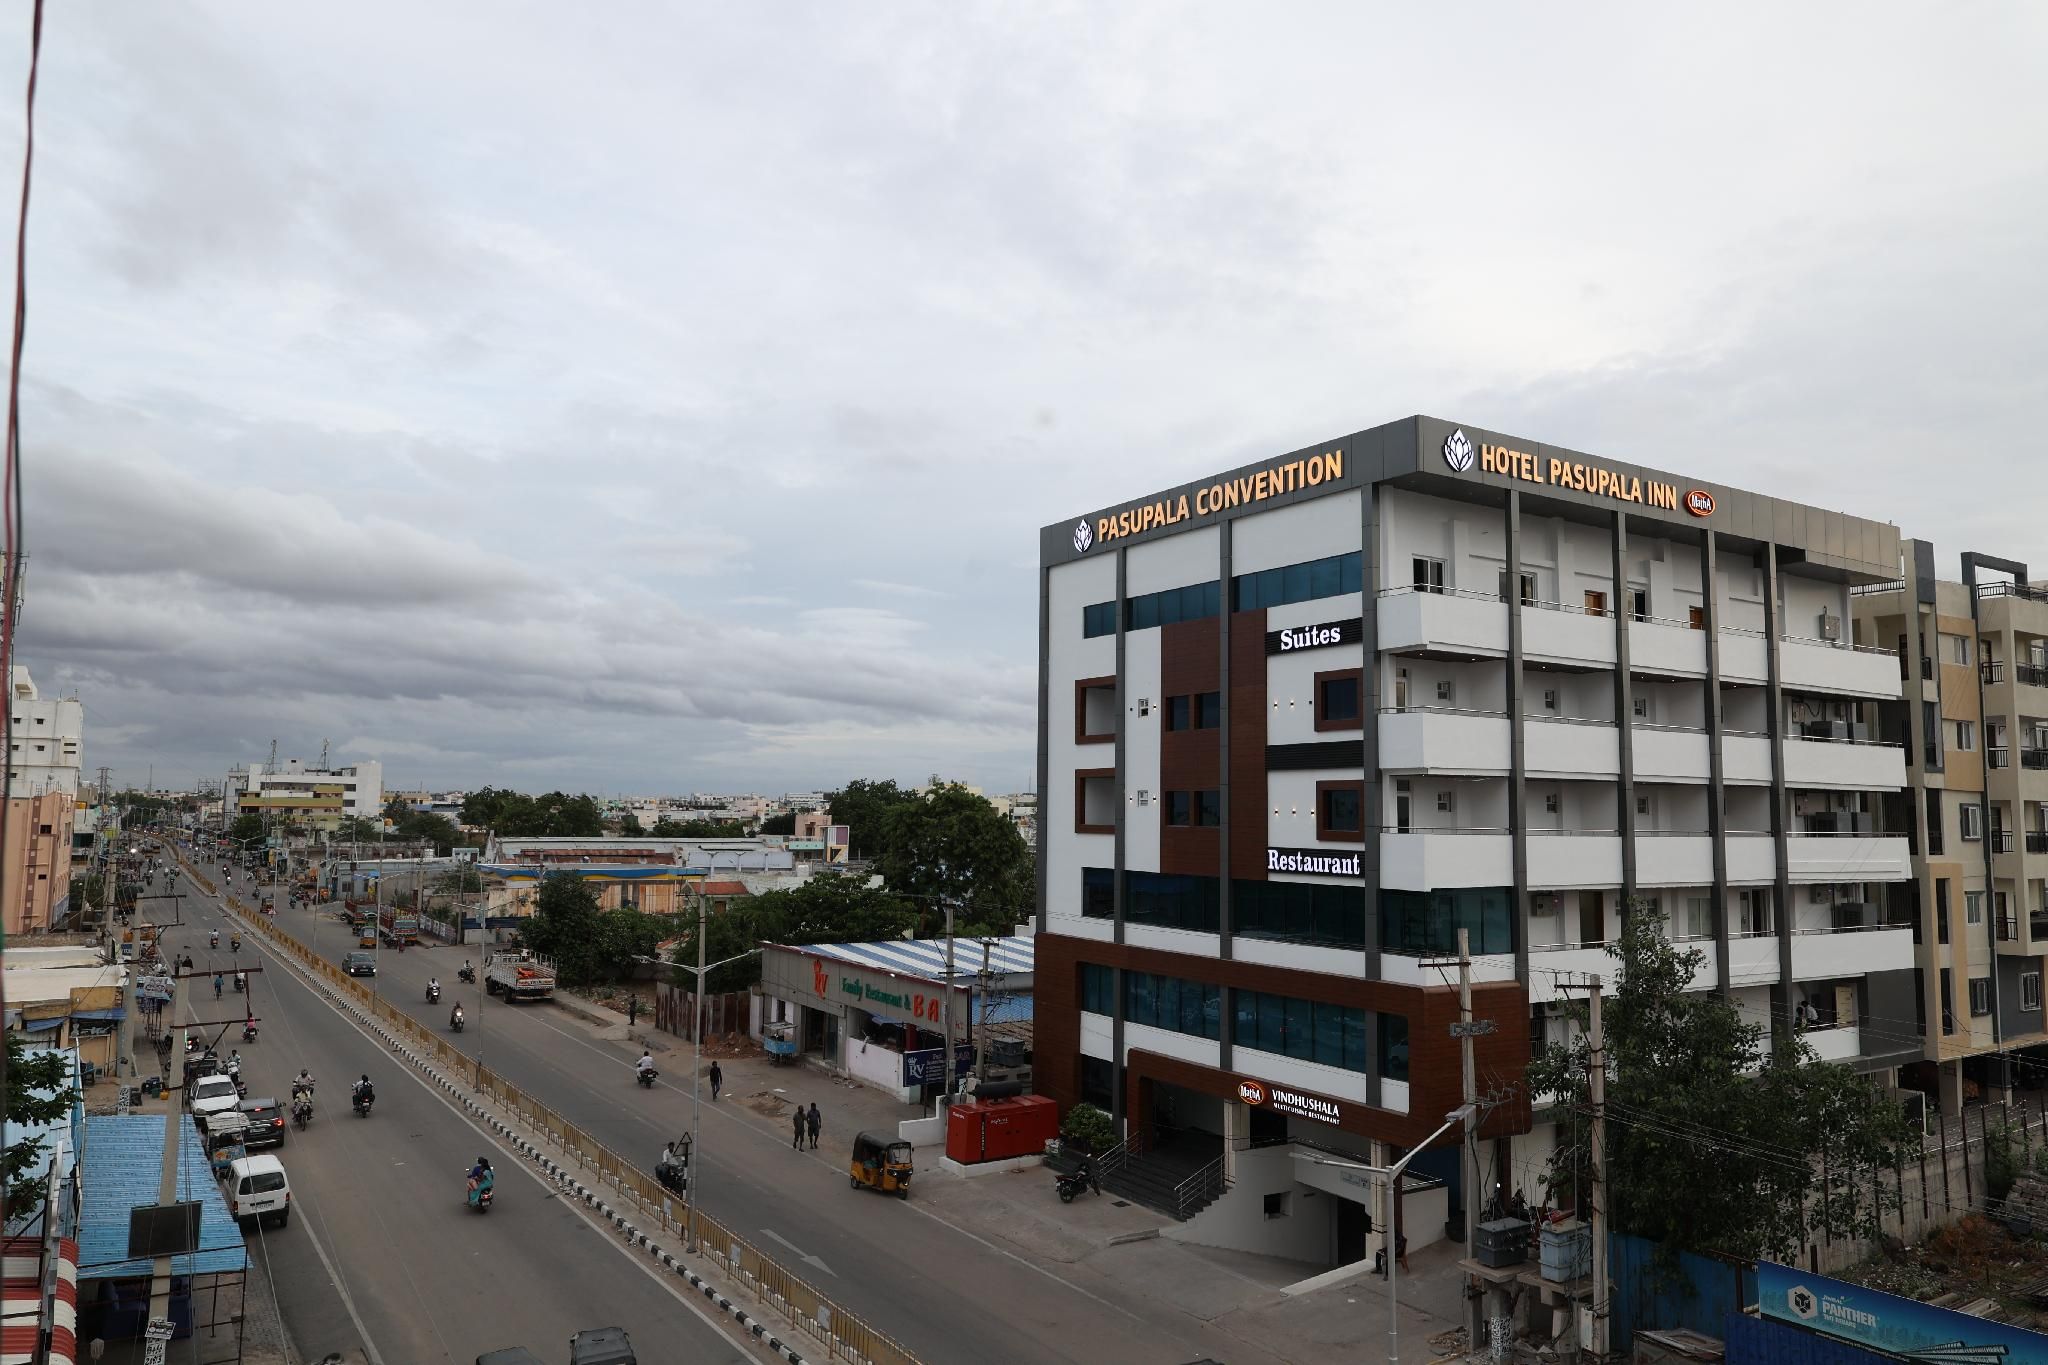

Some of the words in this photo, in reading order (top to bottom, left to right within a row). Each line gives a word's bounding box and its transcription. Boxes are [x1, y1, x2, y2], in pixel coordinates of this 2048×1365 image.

[1481, 443, 1543, 483] HOTEL
[1550, 458, 1642, 503] PASUPALA
[1648, 480, 1677, 511] INN
[1098, 494, 1190, 543] PASUPALA
[1196, 449, 1344, 516] CONVENTION
[1280, 625, 1341, 650] Suites
[1267, 849, 1360, 875] Restaurant
[842, 977, 863, 1001] Family
[908, 1064, 925, 1078] RV
[1272, 1089, 1340, 1117] VINDHUSHALA
[1273, 1102, 1307, 1116] MULTICUISINE
[1308, 1111, 1340, 1125] RESTAURANT
[1822, 1301, 1877, 1328] PANTHER
